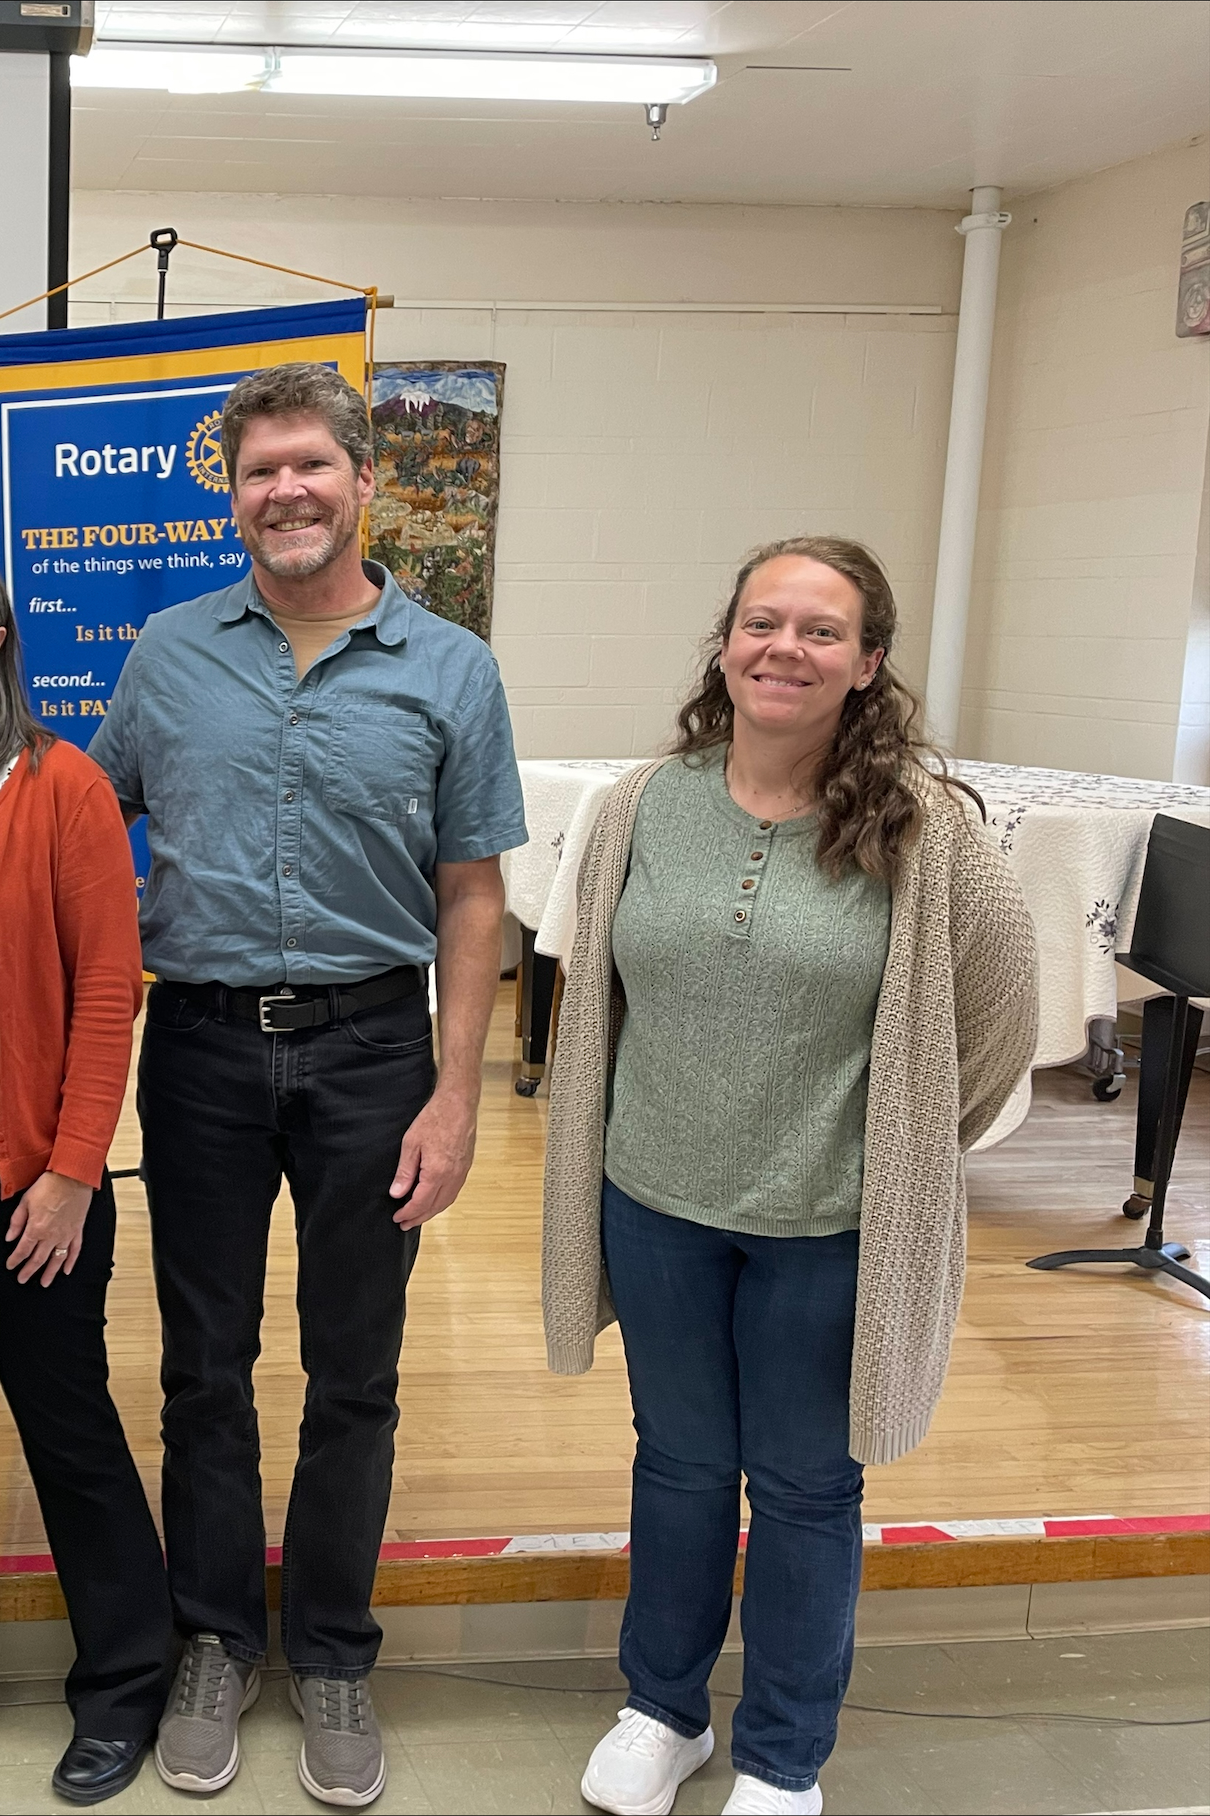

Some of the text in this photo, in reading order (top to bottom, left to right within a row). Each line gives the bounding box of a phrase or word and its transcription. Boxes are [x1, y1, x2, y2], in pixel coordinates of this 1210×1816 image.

[55, 443, 177, 478] Rotary
[21, 527, 79, 550] THE
[82, 517, 228, 548] FOUR-WAY
[31, 558, 49, 574] of
[52, 558, 80, 573] the
[84, 556, 134, 575] things
[138, 558, 163, 570] we
[166, 551, 214, 569] think,
[219, 552, 246, 568] say
[29, 597, 77, 613] first...
[75, 625, 94, 641] Is
[98, 624, 114, 641] it
[32, 671, 106, 688] second...
[40, 700, 58, 716] Is
[61, 700, 75, 716] it
